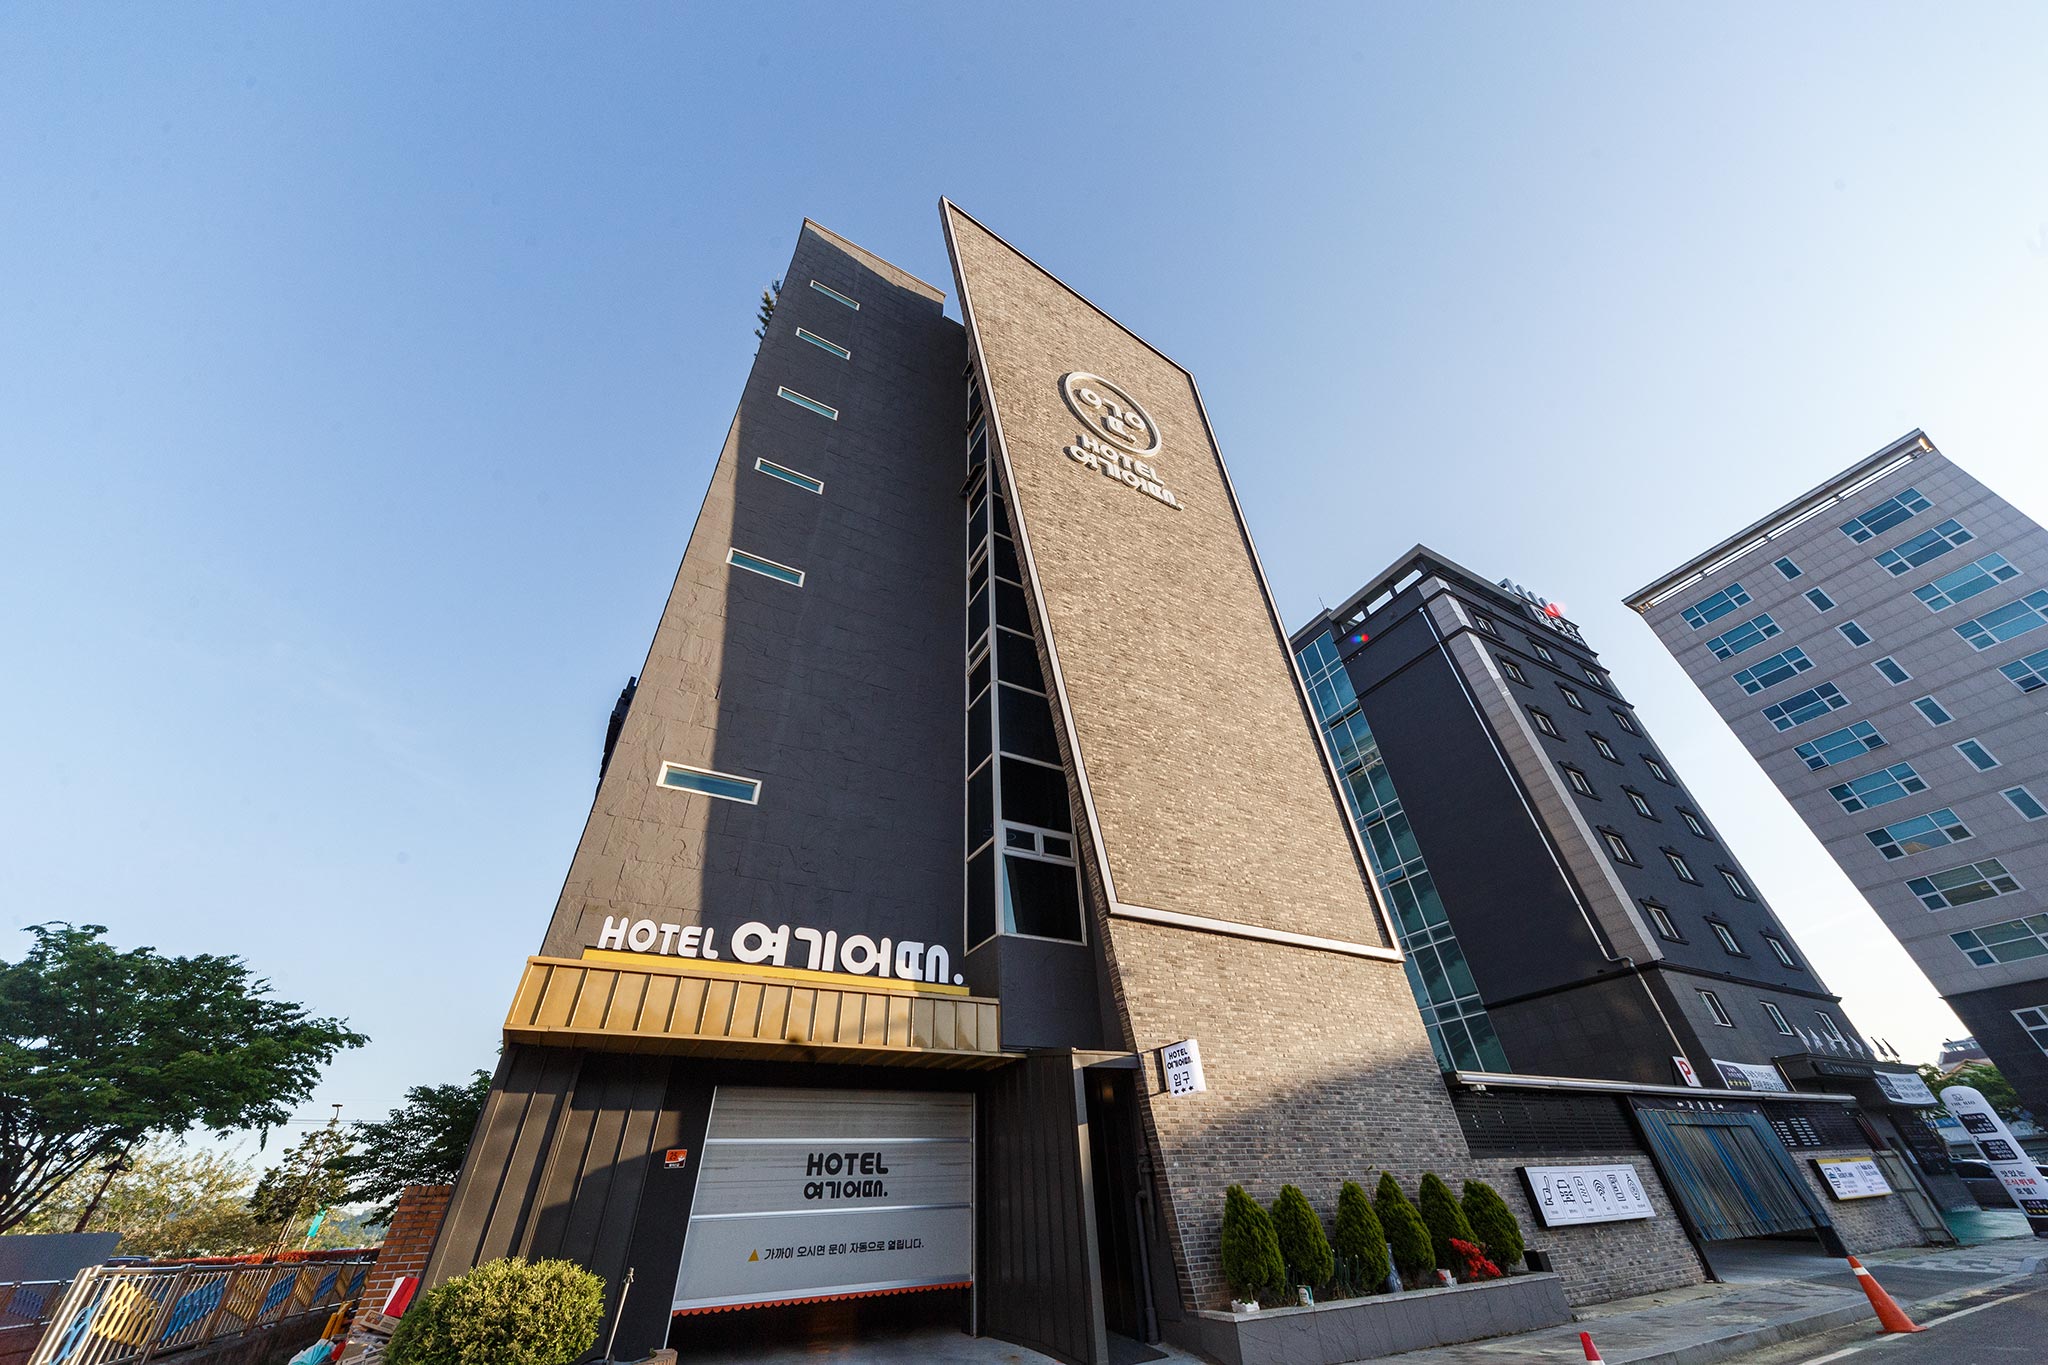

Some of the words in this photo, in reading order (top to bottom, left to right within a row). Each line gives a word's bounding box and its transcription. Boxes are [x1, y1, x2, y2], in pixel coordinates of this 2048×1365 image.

[1081, 433, 1165, 487] HOTEL
[597, 915, 719, 960] HOTEL
[1168, 1047, 1188, 1060] HOTEL
[1173, 1071, 1190, 1087] 입구
[1677, 1060, 1692, 1083] P
[806, 1152, 889, 1176] HOTEL
[2000, 1169, 2026, 1178] 맛있는
[764, 1247, 794, 1260] 가까이
[797, 1245, 826, 1258] 오시면
[828, 1243, 847, 1255] 문이
[850, 1240, 885, 1253] 자동으로
[888, 1238, 924, 1251] 열립니다.
